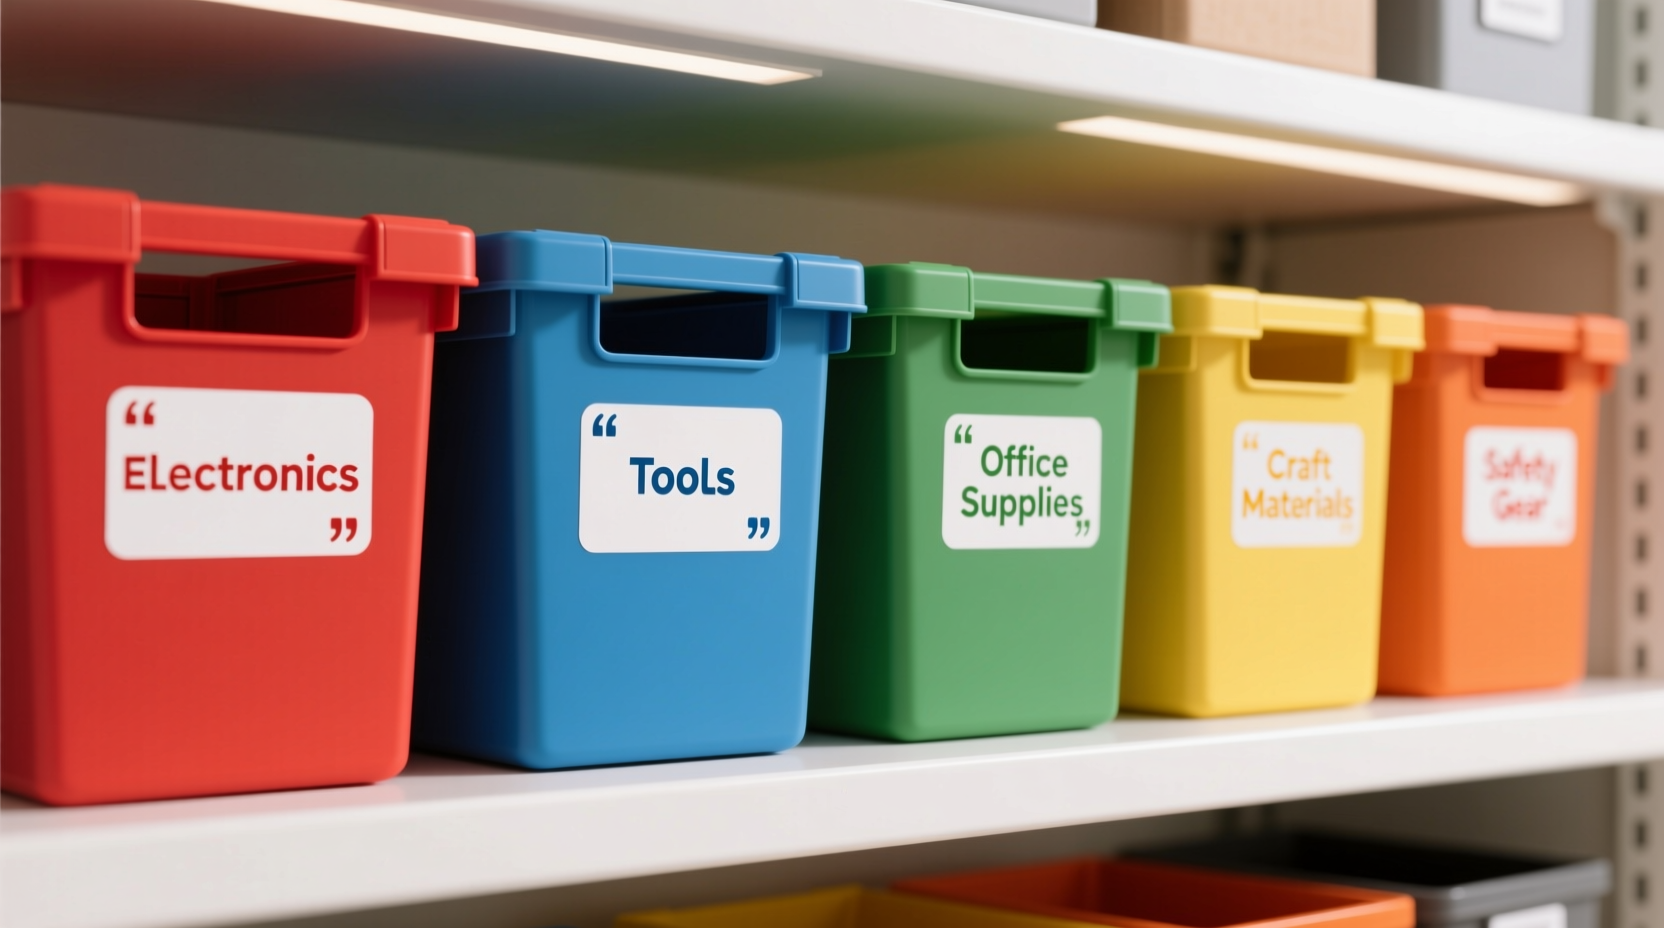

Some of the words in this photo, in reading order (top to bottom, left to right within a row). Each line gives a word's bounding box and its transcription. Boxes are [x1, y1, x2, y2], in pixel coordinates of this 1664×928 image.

[980, 444, 1069, 477] Office
[1267, 448, 1331, 481] Craft
[1484, 447, 1556, 492] Safety
[961, 485, 1083, 526] Supplies
[1242, 488, 1353, 519] Materials
